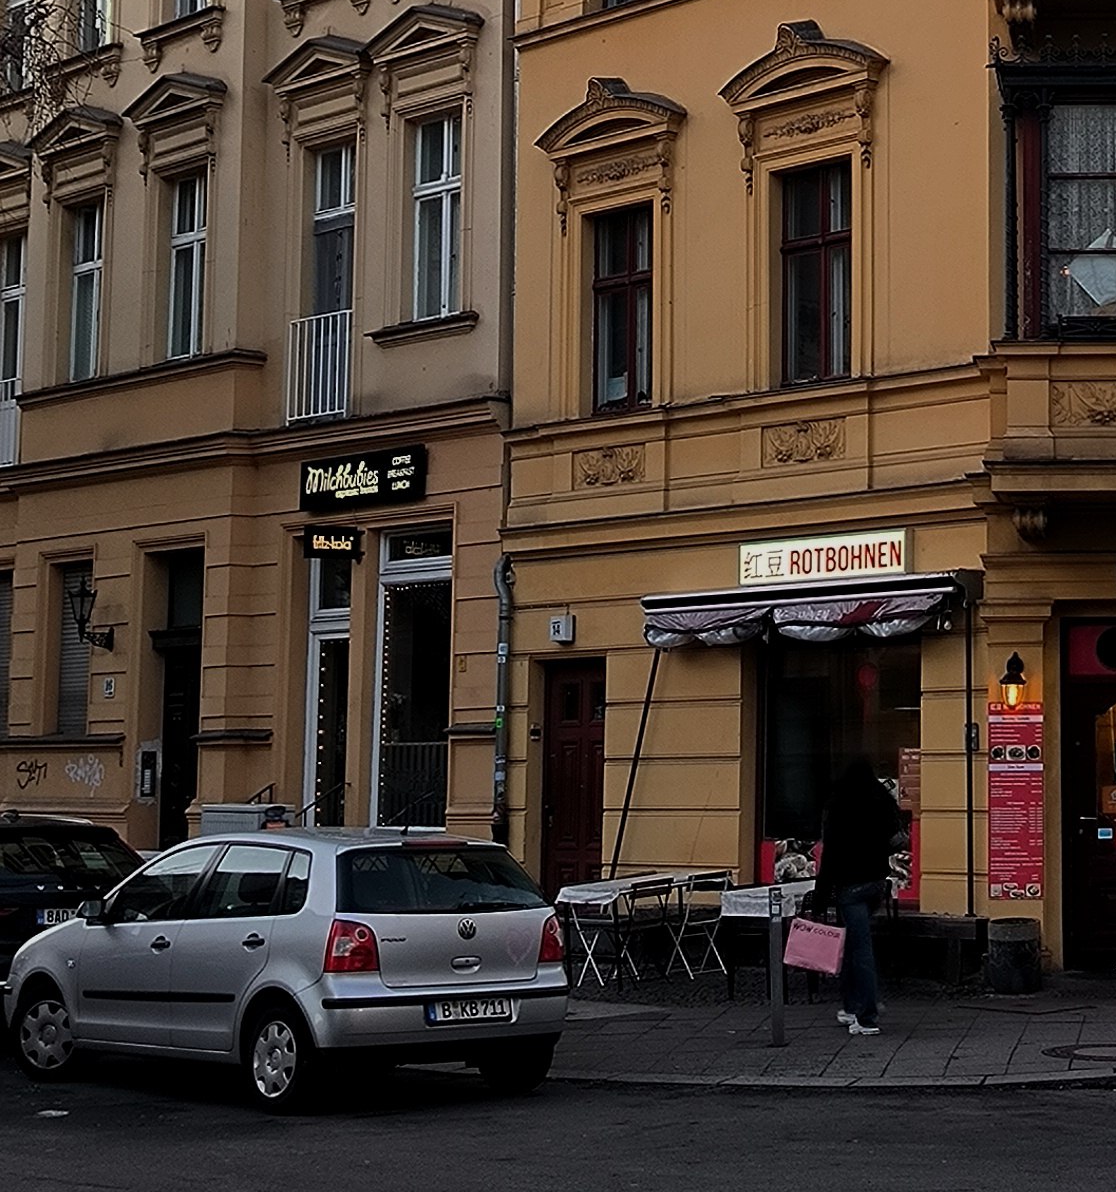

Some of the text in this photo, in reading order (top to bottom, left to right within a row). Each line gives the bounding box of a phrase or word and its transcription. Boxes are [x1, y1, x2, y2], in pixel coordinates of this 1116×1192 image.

[305, 460, 379, 495] Milchbubies
[790, 540, 902, 575] ROTBOHNEN
[442, 1002, 452, 1019] B
